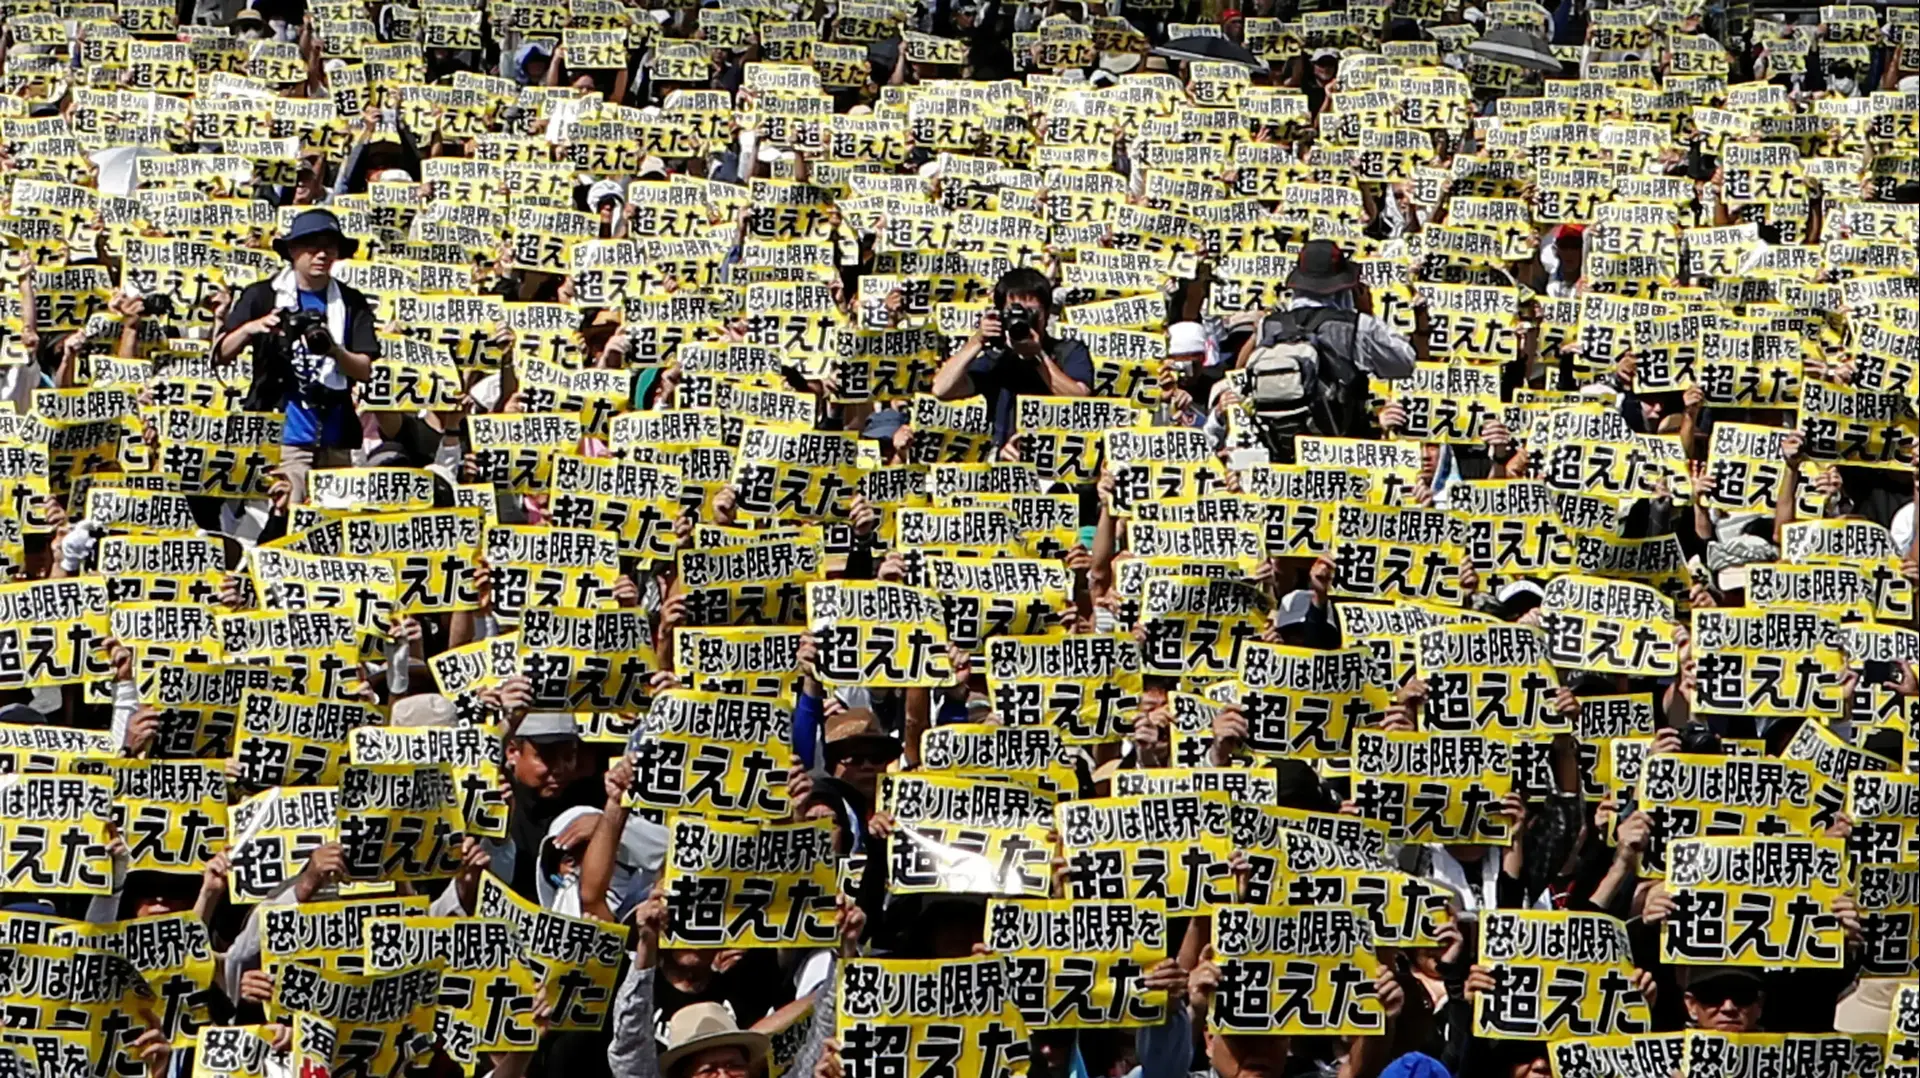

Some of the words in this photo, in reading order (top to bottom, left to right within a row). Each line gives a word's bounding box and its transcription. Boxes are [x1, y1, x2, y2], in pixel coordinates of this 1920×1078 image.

[15, 26, 65, 42] 超えた
[121, 8, 174, 32] 超えた
[512, 7, 563, 30] 超えた
[840, 18, 895, 37] 超えた
[1826, 22, 1876, 41] 超えた
[427, 27, 480, 48] 超えた
[704, 25, 750, 46] 超えた
[906, 40, 962, 61] 超えた
[1305, 30, 1362, 49] 超えた
[1593, 28, 1647, 48] 超えた
[193, 54, 246, 72] 超えた
[251, 59, 306, 80] 超えた
[568, 46, 623, 66] 超えた
[651, 58, 708, 79] 超えた
[1041, 48, 1092, 65] 超えた
[1672, 52, 1728, 71] 超えた
[132, 62, 194, 90] 超えた
[197, 113, 264, 140] 超えた
[1402, 101, 1469, 125] 超えた
[273, 118, 341, 147] 超えた
[834, 134, 901, 157] 超えた
[913, 119, 978, 145] 超えた
[1049, 119, 1111, 142] 超えた
[568, 145, 636, 172] 超えた
[431, 180, 504, 202] 超えた
[504, 171, 571, 193] 超えた
[1236, 169, 1306, 194] 超えた
[1725, 170, 1804, 198] 超えた
[517, 211, 599, 236] 怒りは限界を
[631, 205, 706, 237] 超えた
[750, 207, 830, 236] 超えた
[958, 213, 1045, 241] 怒りは限界を
[1118, 208, 1200, 236] 怒りは限界を
[126, 239, 220, 264] 怒りは限界を
[747, 244, 833, 265] 怒りは限界を
[1602, 226, 1675, 252] 超えた
[1080, 251, 1165, 271] 怒りは限界を
[575, 271, 661, 302] 超えた
[1418, 287, 1513, 311] 怒りは限界を
[400, 300, 500, 322] 怒りは限界を
[625, 300, 721, 322] 怒りは限界を
[1071, 300, 1165, 325] 怒りは限界を
[749, 315, 833, 349] 超えた
[838, 331, 935, 355] 怒りは限界を
[1702, 332, 1799, 362] 怒りは限界を
[680, 346, 780, 372] 怒りは限界を
[359, 369, 460, 404] 超えた
[525, 360, 627, 392] 怒りは限界を
[838, 360, 934, 400] 超えた
[1701, 364, 1800, 402] 超えた
[37, 391, 138, 416] 怒りは限界を
[716, 384, 812, 419] 怒りは限界を
[1022, 401, 1126, 427] 怒りは限界を
[1402, 399, 1495, 437] 超えた
[169, 410, 281, 445] 怒りは限界を
[473, 415, 580, 445] 怒りは限界を
[612, 413, 717, 444] 怒りは限界を
[1804, 418, 1914, 462] 超えた
[745, 430, 858, 467] 怒りは限界を
[1301, 440, 1418, 467] 怒りは限界を
[165, 446, 273, 494] 超えた
[558, 459, 681, 498] 怒りは限界を
[935, 465, 1038, 494] 怒りは限界を
[1251, 468, 1363, 500] 怒りは限界を
[1550, 445, 1657, 491] 超えた
[313, 471, 430, 501] 怒りは限界を
[736, 467, 851, 517] 超えた
[1116, 467, 1226, 508] 超えた
[348, 513, 479, 554] 怒りは限界を
[553, 495, 673, 552] 超えた
[902, 508, 1019, 543] 怒りは限界を
[1133, 523, 1258, 556] 怒りは限界を
[1338, 505, 1467, 544] 怒りは限界を
[102, 540, 224, 572] 怒りは限界を
[487, 531, 617, 568] 怒りは限界を
[683, 544, 820, 586] 怒りは限界を
[257, 551, 390, 584] 怒りは限界を
[934, 561, 1064, 592] 怒りは限界を
[1335, 547, 1460, 598] 超えた
[1547, 581, 1671, 621] 怒りは限界を
[1751, 569, 1874, 600] 怒りは限界を
[686, 583, 806, 625] 超えた
[813, 586, 943, 620] 怒りは限界を
[222, 616, 353, 651] 怒りは限界を
[524, 610, 650, 648] 怒りは限界を
[1144, 620, 1263, 671] 超えた
[1550, 615, 1672, 669] 超えた
[1698, 612, 1840, 648] 怒りは限界を
[815, 626, 950, 681] 超えた
[991, 639, 1140, 678] 怒りは限界を
[526, 654, 651, 709] 超えた
[1246, 648, 1382, 693] 怒りは限界を
[1698, 655, 1840, 711] 超えた
[995, 684, 1135, 736] 超えた
[1424, 675, 1565, 732] 超えた
[356, 730, 500, 764] 怒りは限界を
[925, 727, 1070, 768] 怒りは限界を
[1359, 735, 1509, 776] 怒りは限界を
[629, 741, 790, 813] 超えた
[1646, 760, 1809, 806] 怒りは限界を
[899, 778, 1052, 827] 怒りは限界を
[1357, 781, 1507, 837] 超えた
[1067, 799, 1227, 846] 怒りは限界を
[342, 816, 464, 877] 超えた
[675, 822, 834, 870] 怒りは限界を
[1070, 849, 1230, 909] 超えた
[1671, 842, 1839, 886] 怒りは限界を
[668, 876, 837, 943] 超えた
[1668, 890, 1838, 959] 超えた
[991, 906, 1163, 949] 怒りは限界を
[1218, 908, 1373, 955] 怒りは限界を
[370, 925, 528, 968] 怒りは限界を
[280, 964, 439, 1023] 怒りは限界を
[1009, 958, 1163, 1023] 超えた
[1215, 961, 1380, 1029] 超えた
[1482, 965, 1648, 1035] 超えた
[1691, 1036, 1881, 1078] 怒りは限界を
